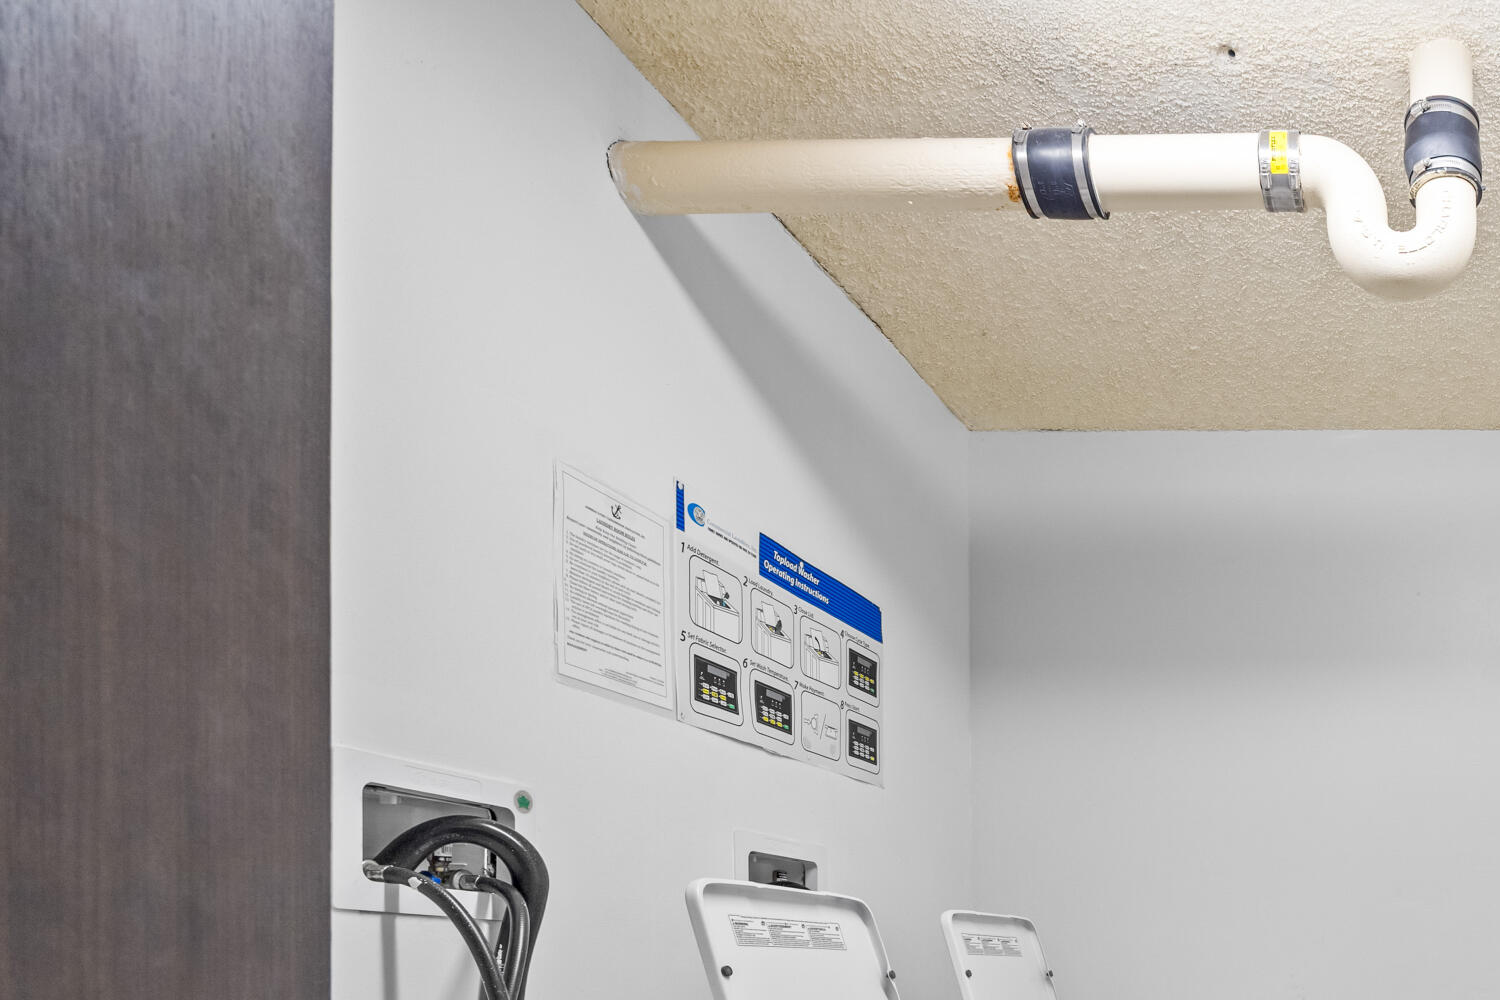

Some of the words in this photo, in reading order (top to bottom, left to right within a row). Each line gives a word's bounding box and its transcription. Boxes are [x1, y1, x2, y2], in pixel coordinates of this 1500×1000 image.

[687, 544, 696, 553] Add
[773, 551, 798, 573] Topload
[798, 561, 820, 586] Washer
[743, 575, 748, 587] 2
[763, 560, 794, 586] Operating
[795, 578, 830, 604] Instructions
[680, 630, 686, 642] 5
[687, 631, 695, 640] Set
[742, 658, 748, 669] 6
[794, 680, 798, 690] 7
[840, 699, 844, 710] 8
